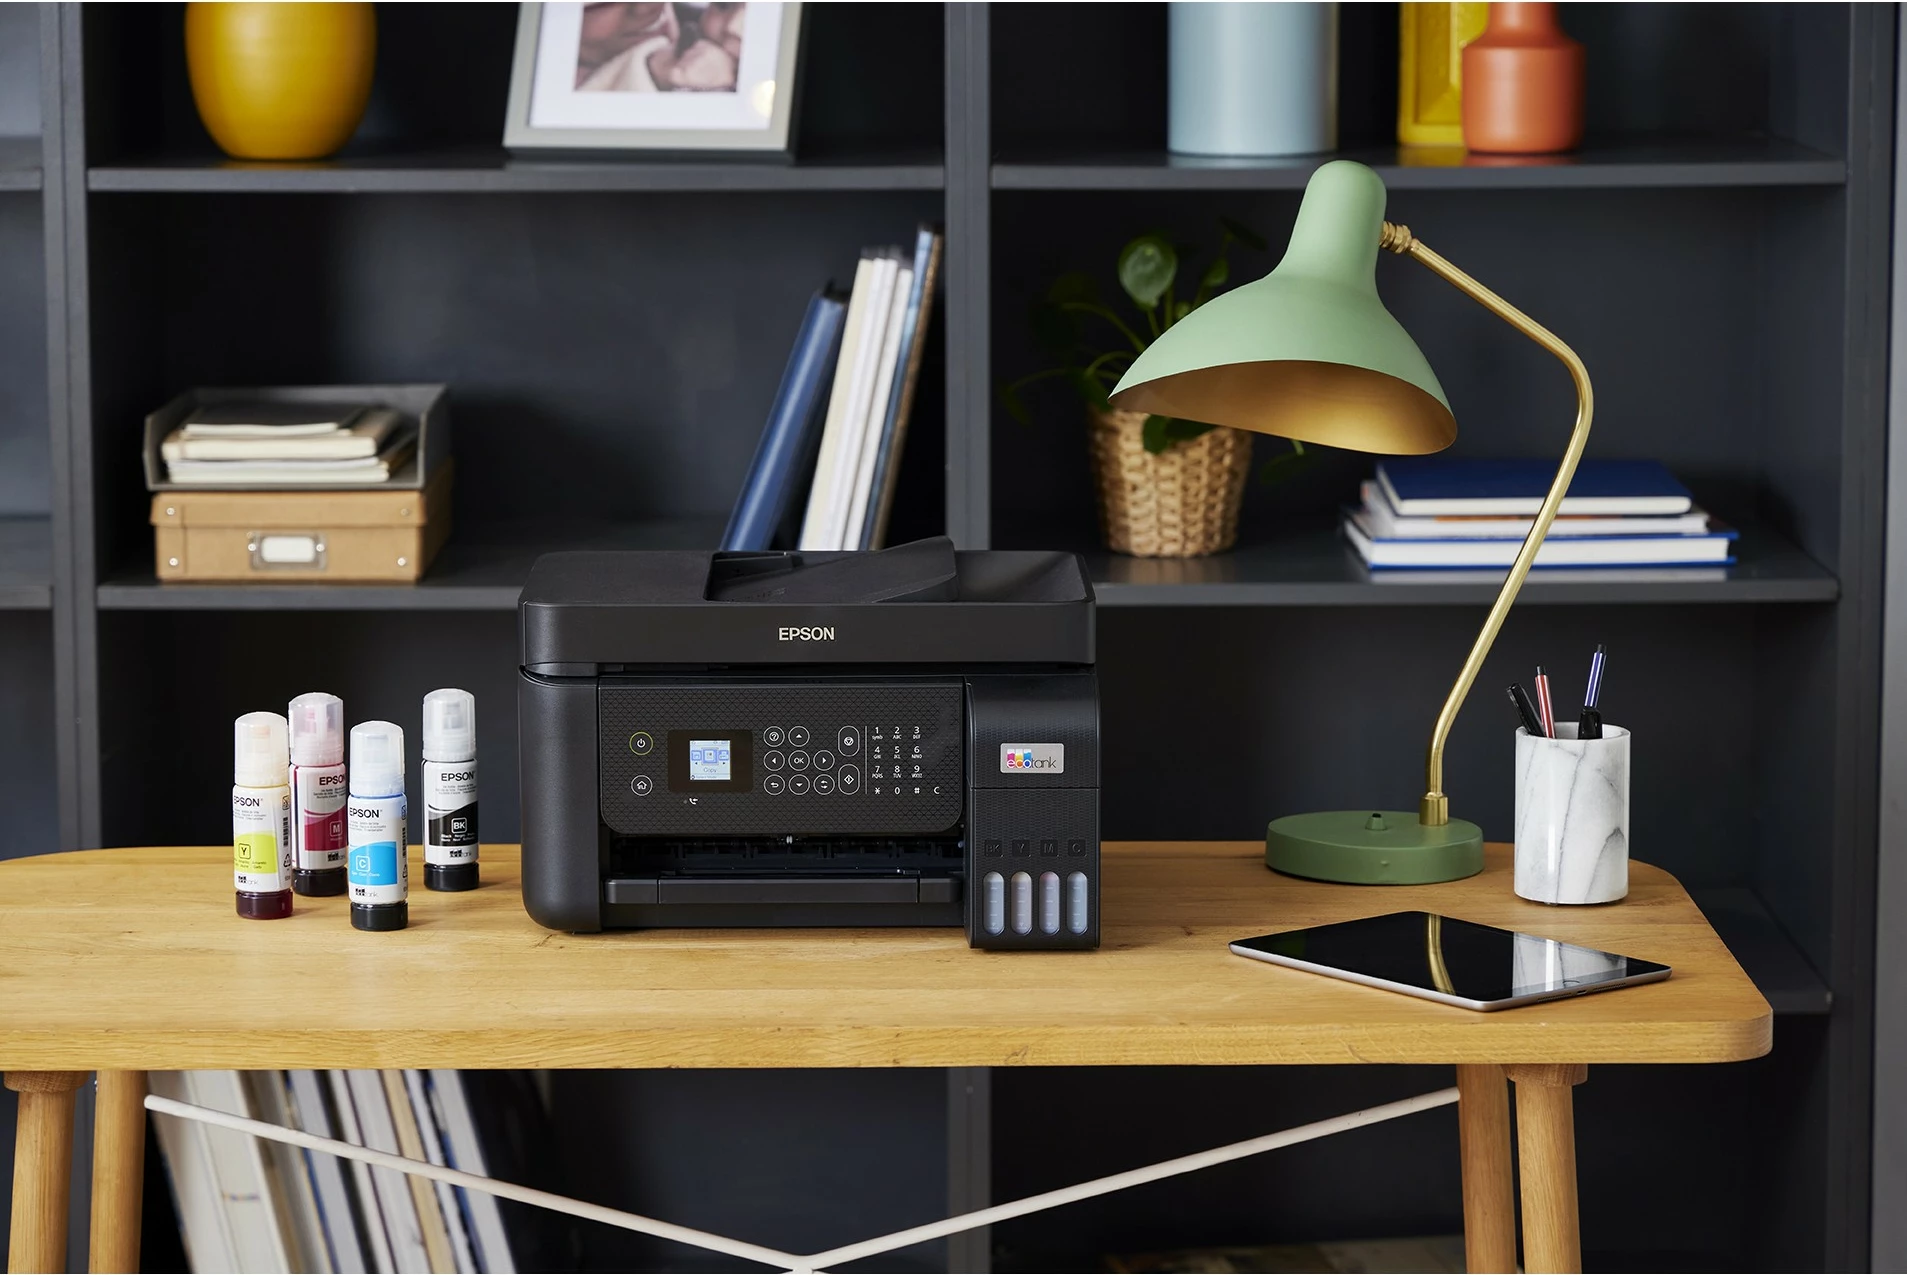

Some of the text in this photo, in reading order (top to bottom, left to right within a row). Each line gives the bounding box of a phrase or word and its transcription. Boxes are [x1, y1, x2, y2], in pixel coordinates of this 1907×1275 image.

[779, 627, 835, 641] EPSON
[874, 726, 879, 734] 1
[894, 726, 900, 734] 2
[913, 726, 920, 734] 3
[894, 745, 900, 754] 5
[913, 745, 920, 754] 6
[1006, 756, 1057, 769] ecotank
[874, 765, 880, 773] 7
[894, 765, 901, 773] 8
[913, 765, 920, 773] 9
[441, 771, 475, 782] EPSON
[894, 786, 901, 795] 0
[933, 786, 940, 795] C
[332, 824, 340, 834] M
[453, 821, 466, 830] BK
[240, 847, 247, 855] Y
[1017, 843, 1025, 853] Y
[1043, 843, 1055, 853] M
[1071, 843, 1081, 853] C
[358, 859, 367, 869] C
